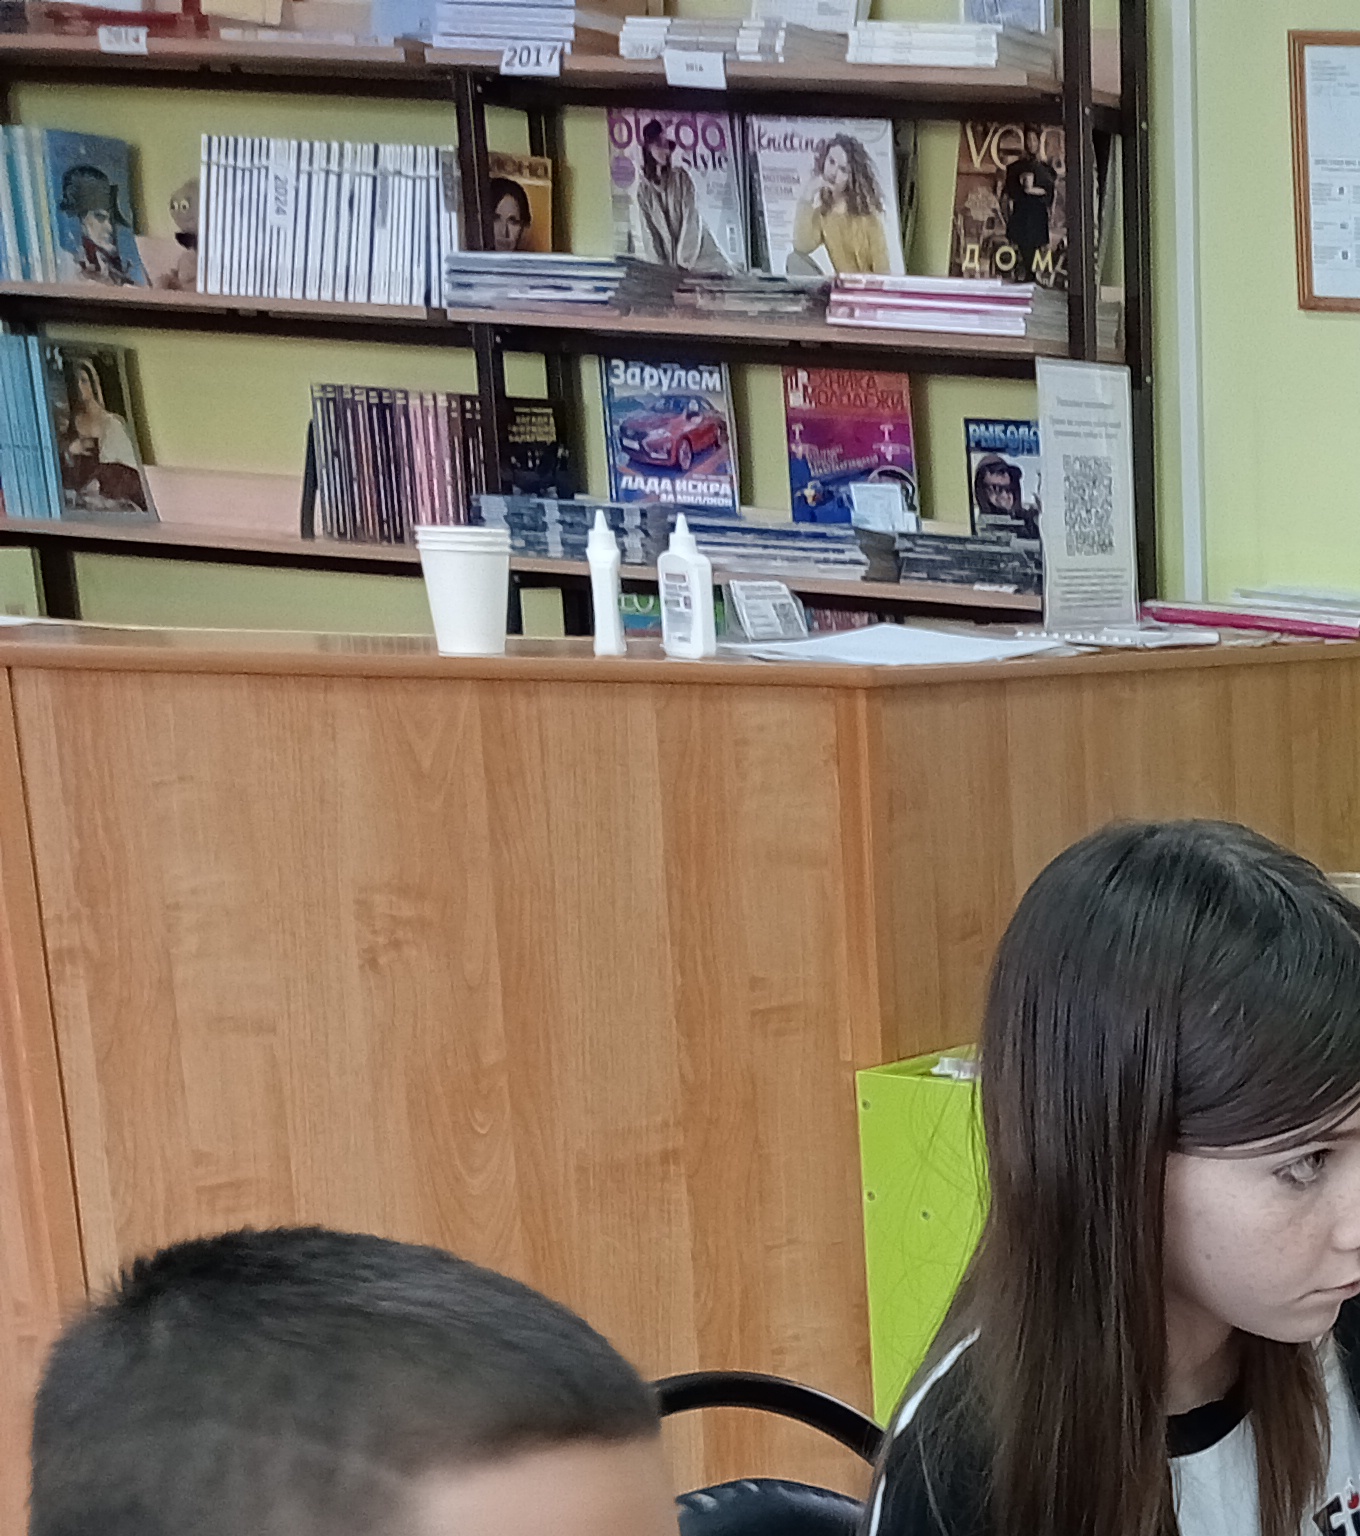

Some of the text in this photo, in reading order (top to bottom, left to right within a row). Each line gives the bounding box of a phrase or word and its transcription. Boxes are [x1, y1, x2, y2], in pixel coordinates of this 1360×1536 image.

[504, 43, 558, 69] 2017
[274, 174, 289, 216] 2024
[968, 423, 1040, 449] РЫБОЛО
[620, 475, 673, 496] ЛАДА
